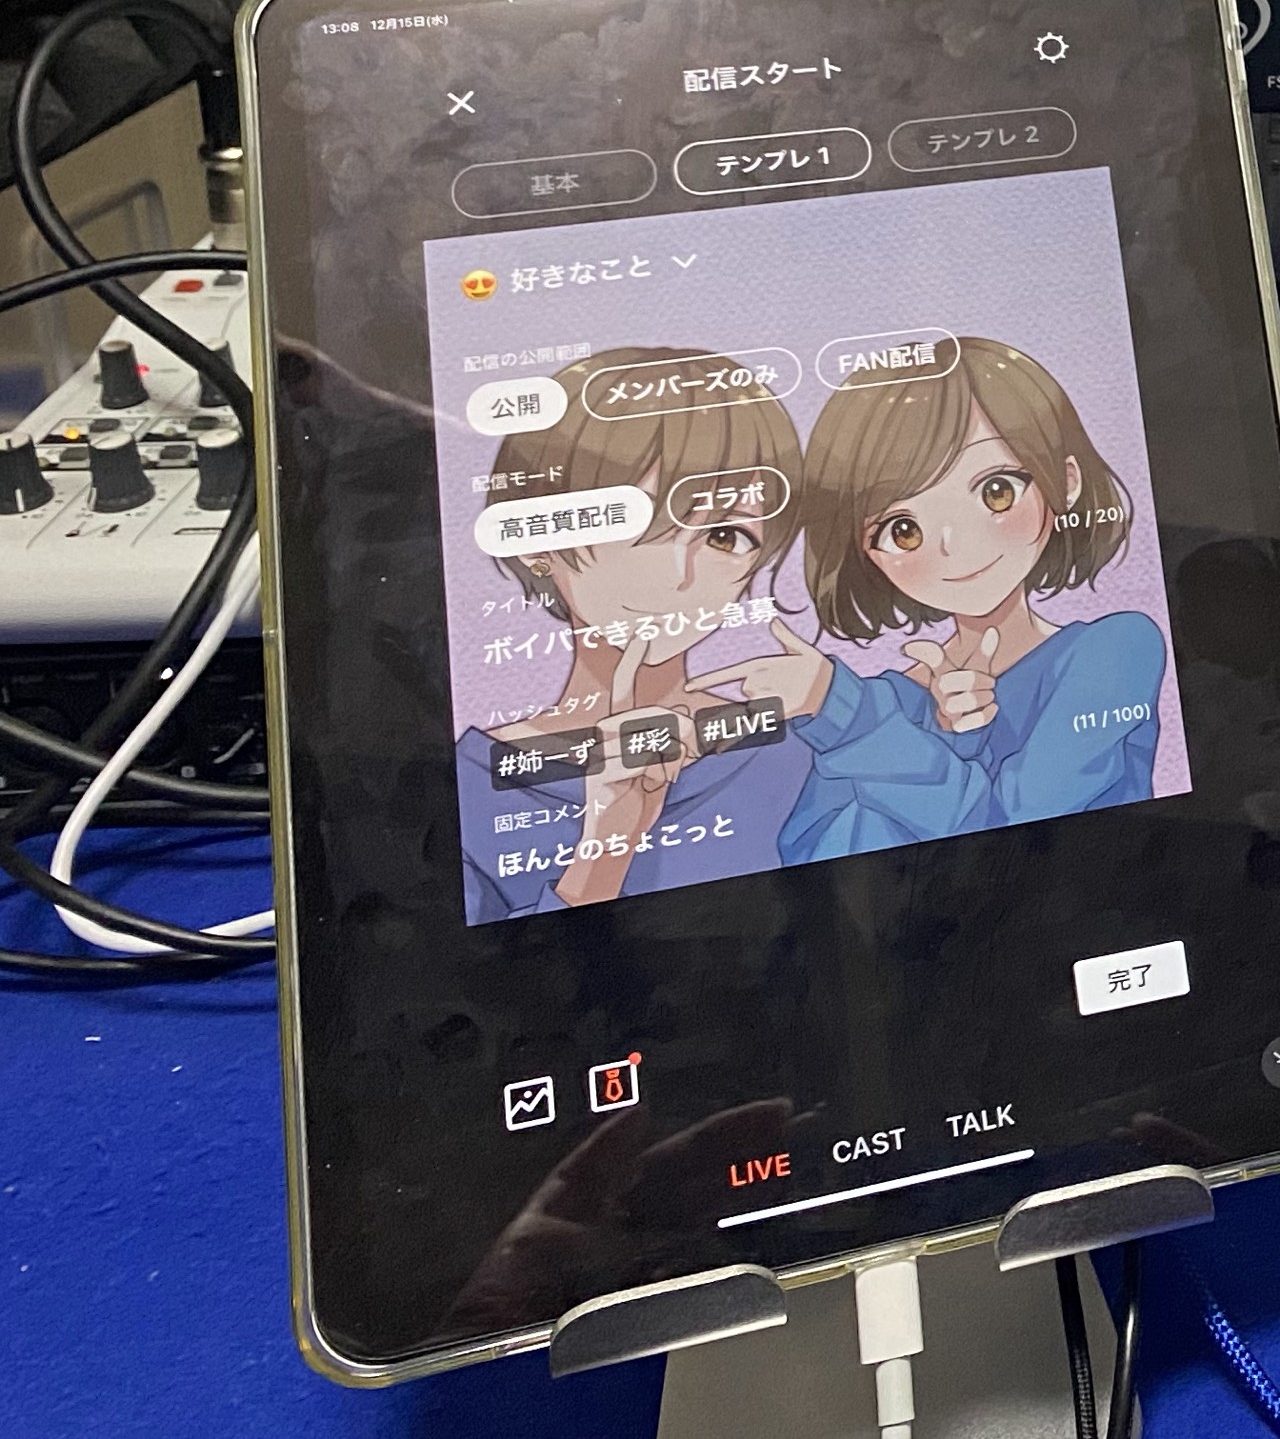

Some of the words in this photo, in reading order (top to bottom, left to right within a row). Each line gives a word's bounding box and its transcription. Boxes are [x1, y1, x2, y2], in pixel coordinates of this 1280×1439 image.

[321, 20, 359, 35] 13:08
[370, 14, 449, 32] 12月15日(水)
[683, 57, 842, 93] 配信スタート
[928, 128, 1017, 155] テンプレ
[1025, 125, 1040, 144] 2
[716, 149, 811, 177] テンプレ
[818, 147, 830, 165] 1
[530, 173, 580, 196] 基本
[511, 257, 652, 293] 好きなこと
[463, 342, 592, 372] 配信の公開範囲
[838, 343, 937, 374] FAN配信
[606, 364, 779, 405] メンバーズのみ
[491, 393, 541, 420] 公開
[471, 466, 564, 492] 配信モード
[691, 481, 766, 512] コラボ
[499, 504, 627, 542] 高音質配信
[481, 593, 556, 618] タイトル
[483, 596, 779, 665] ボイパできるひと急募
[487, 692, 602, 727] ハッシュタグ
[628, 727, 671, 755] #彩
[703, 710, 778, 742] #LIVE
[497, 738, 598, 777] #姉ーず
[494, 799, 607, 834] 固定コメント
[497, 814, 735, 878] ほんとのちょこっと
[1107, 964, 1154, 994] 完了
[946, 1104, 1016, 1139] TALK
[832, 1128, 906, 1164] CAST
[730, 1154, 791, 1187] LIVE
